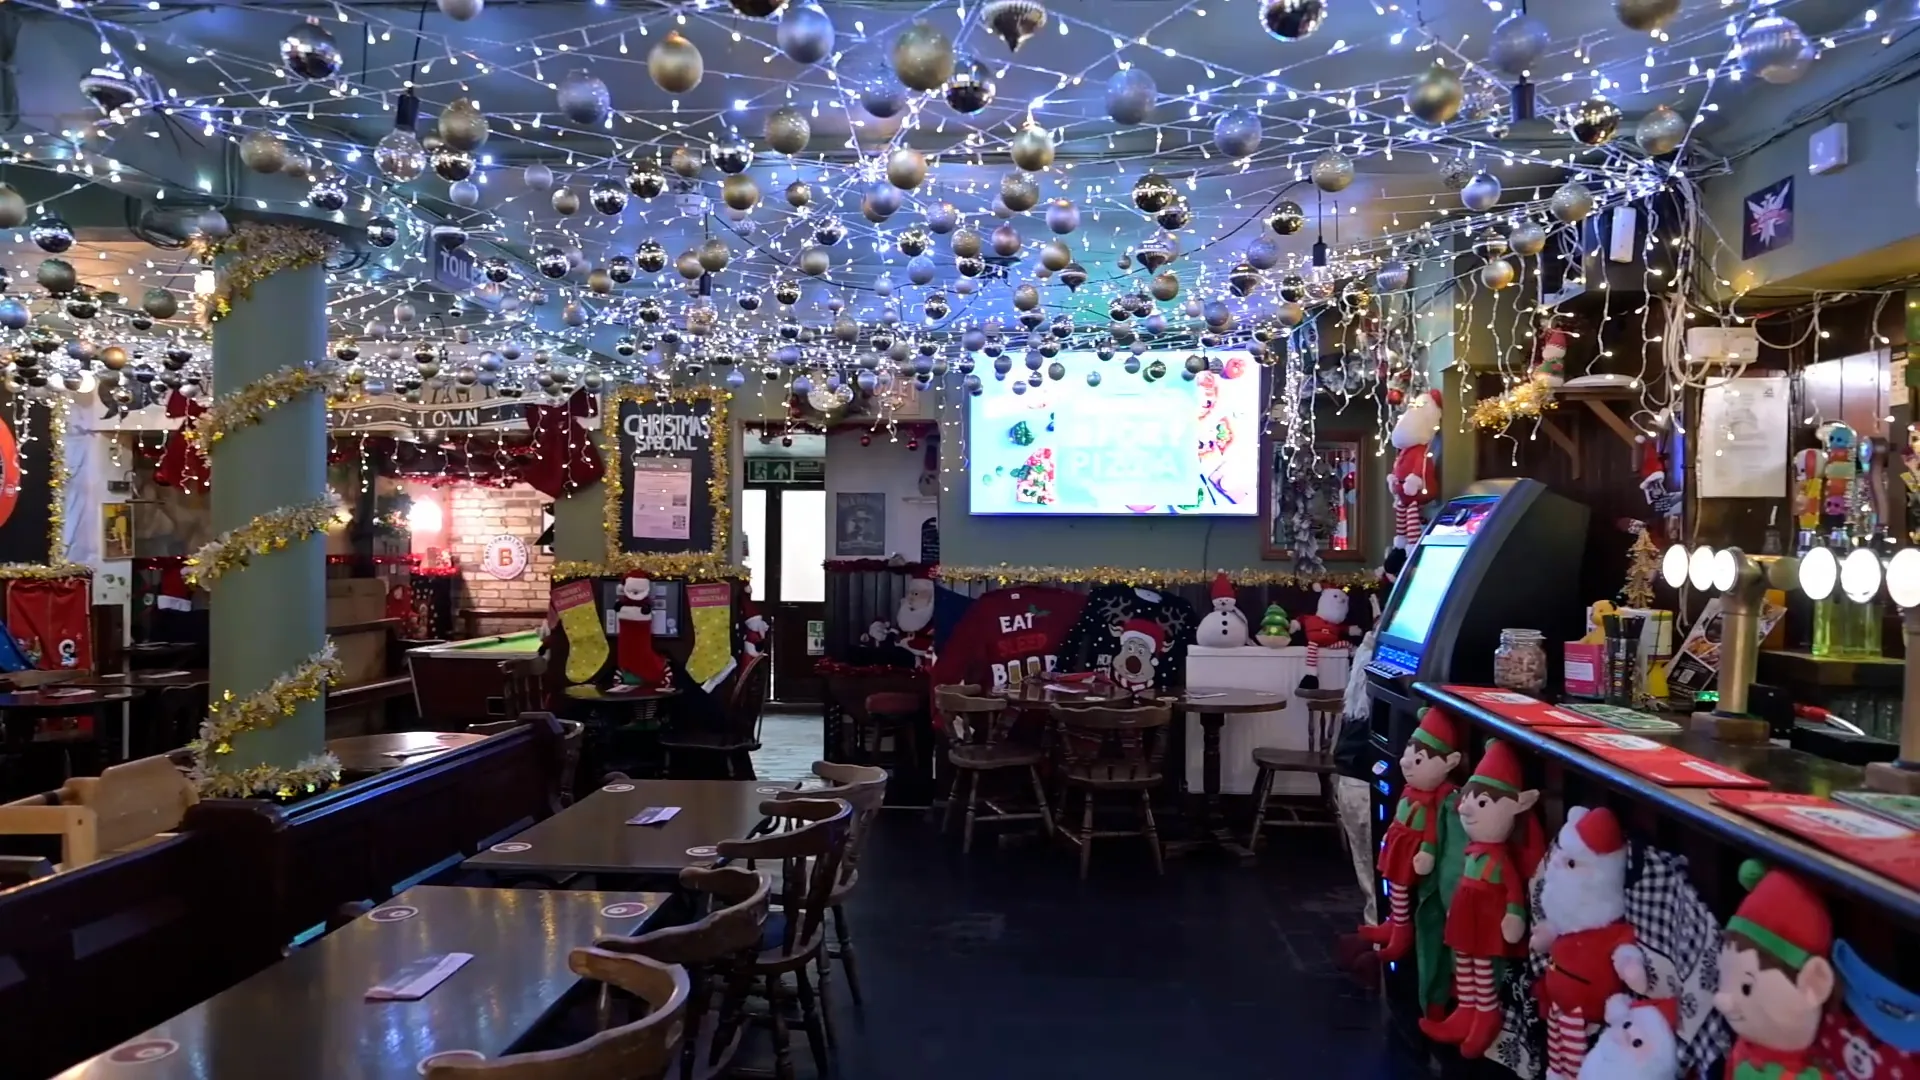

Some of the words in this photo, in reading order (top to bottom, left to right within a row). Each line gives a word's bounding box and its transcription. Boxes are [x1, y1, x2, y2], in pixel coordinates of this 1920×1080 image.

[416, 408, 479, 427] TOWN
[623, 413, 711, 437] CHRISTMAS
[634, 435, 698, 451] SPECIAL
[498, 548, 513, 566] B
[999, 612, 1035, 633] EAT
